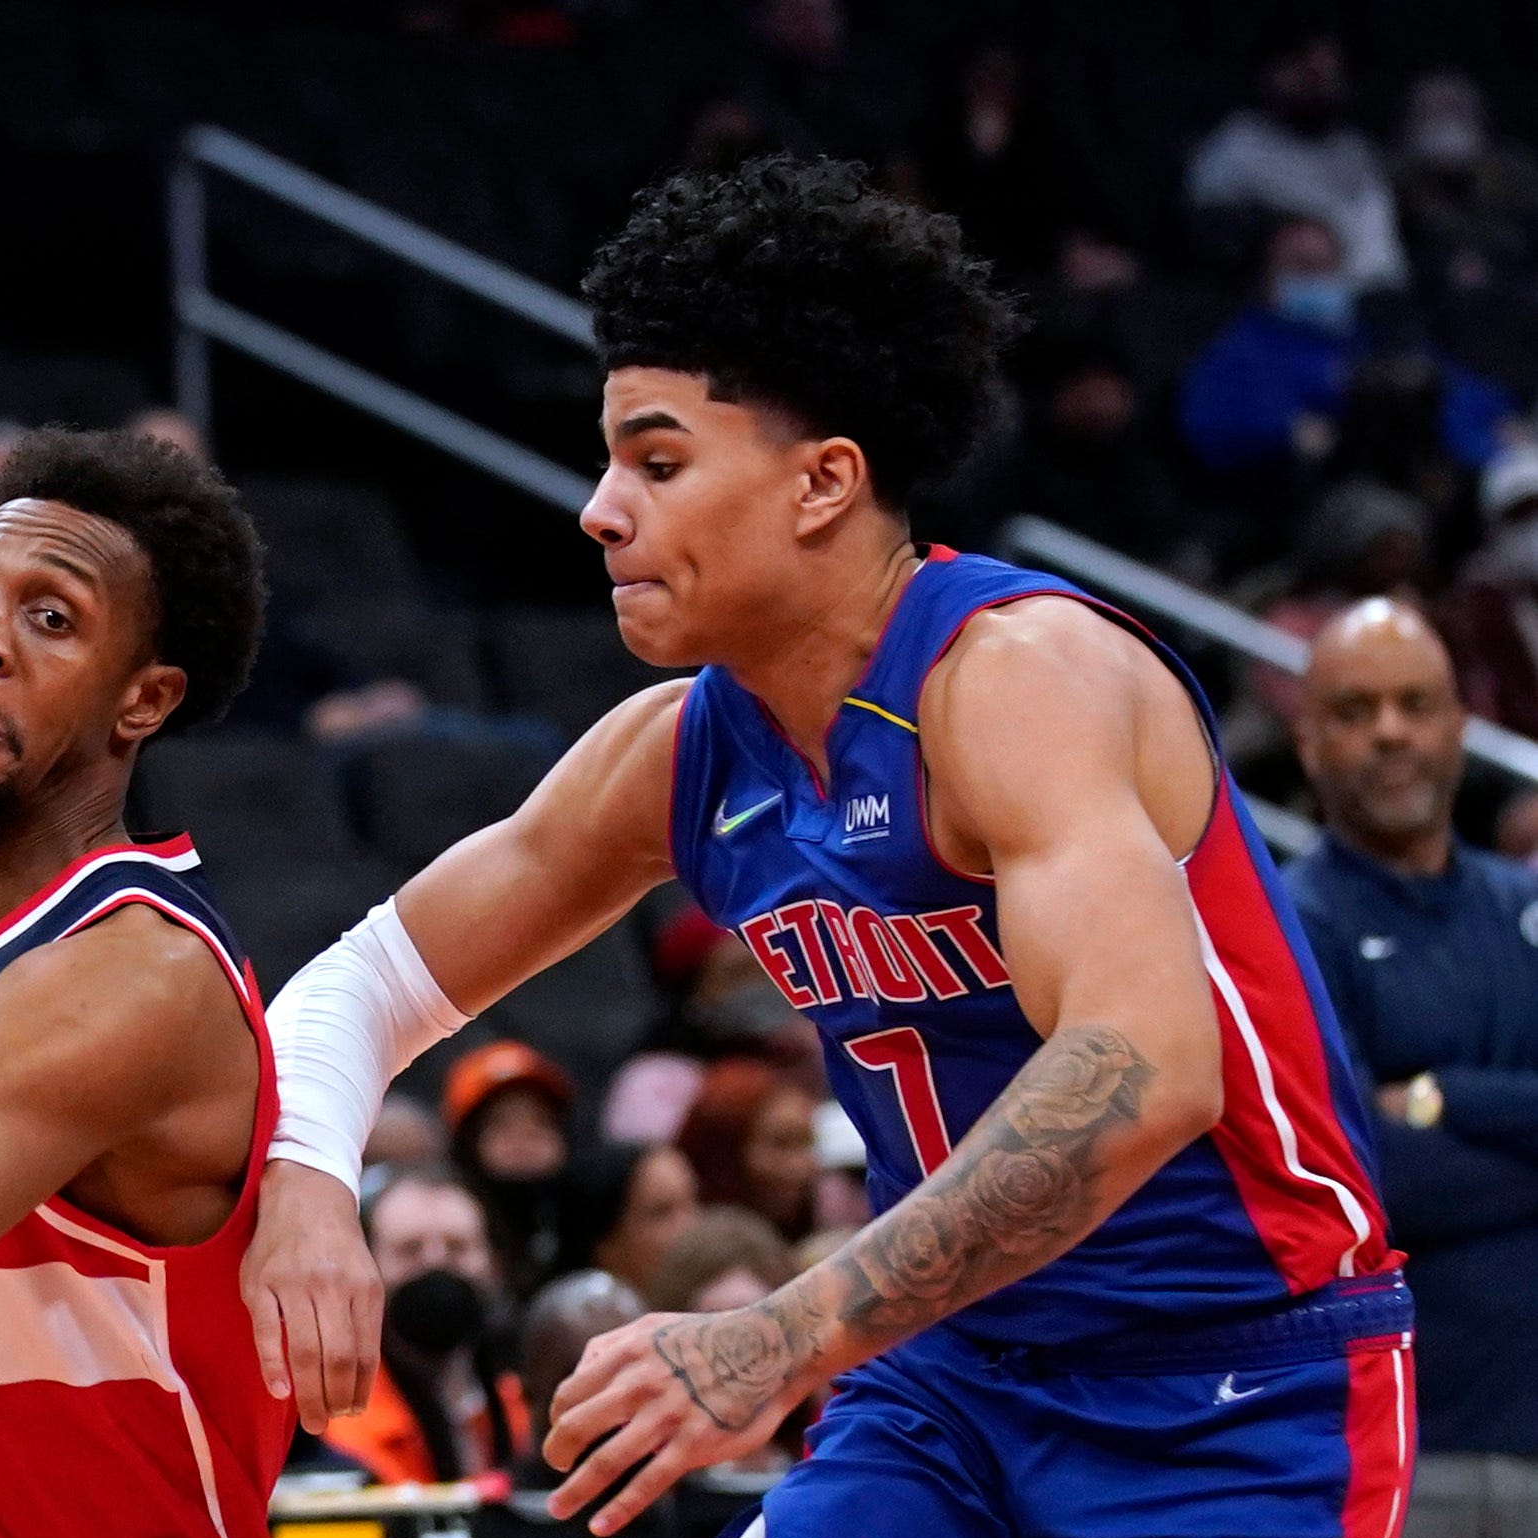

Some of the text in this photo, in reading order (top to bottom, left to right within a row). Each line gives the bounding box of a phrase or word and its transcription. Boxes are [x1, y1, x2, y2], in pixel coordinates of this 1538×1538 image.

[846, 793, 889, 832] UWM
[739, 898, 1012, 1010] ETROIT
[844, 1027, 953, 1178] 7
